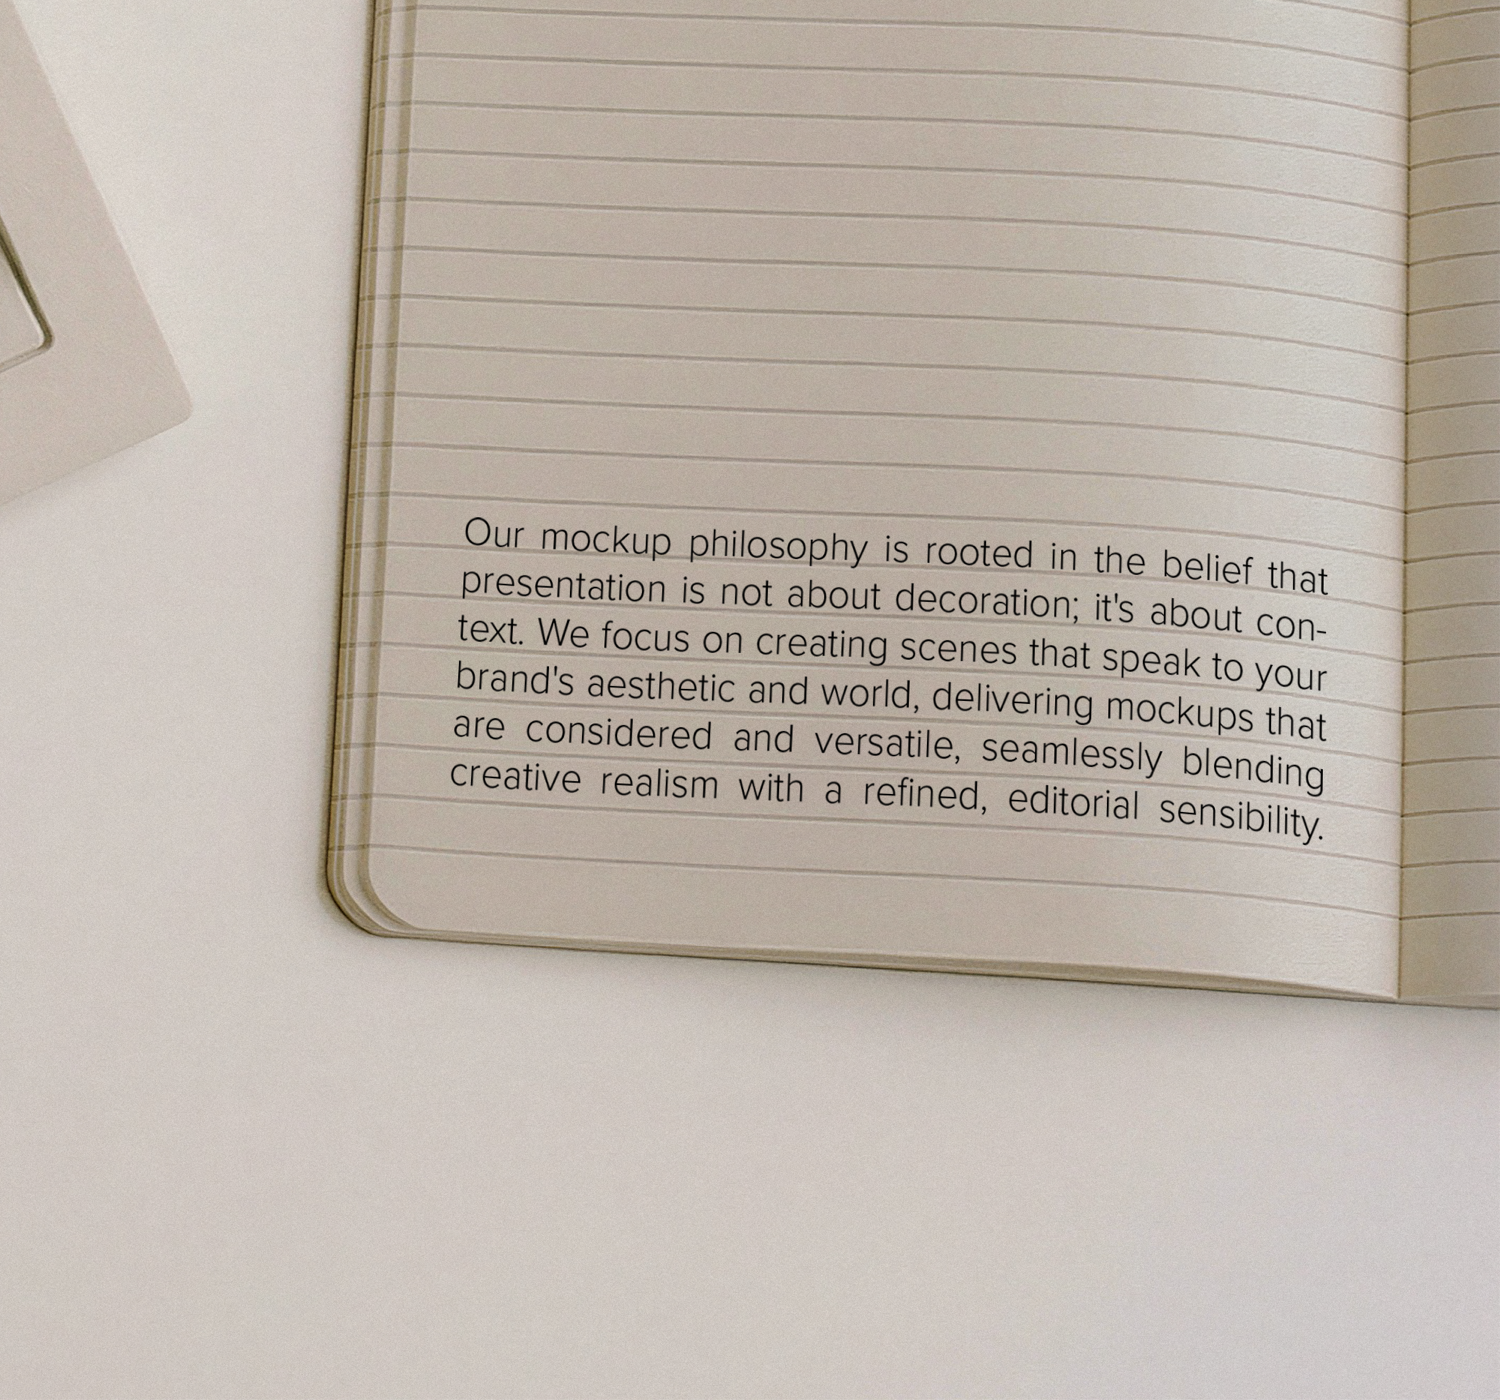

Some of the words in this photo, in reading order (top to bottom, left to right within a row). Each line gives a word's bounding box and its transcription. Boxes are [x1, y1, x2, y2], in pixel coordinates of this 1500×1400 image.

[465, 516, 525, 548] Our
[542, 525, 671, 562] mockup
[690, 528, 869, 569] philosophy
[886, 535, 909, 564] is
[926, 540, 1033, 568] rooted
[1051, 542, 1076, 571] in
[1094, 545, 1146, 576] the
[1164, 549, 1254, 585] belief
[1267, 561, 1329, 596] that
[462, 571, 665, 603] presentation
[682, 576, 705, 605] is
[721, 580, 773, 607] not
[787, 579, 881, 611] about
[895, 582, 1078, 625] decoration;
[1095, 592, 1134, 623] it's
[1150, 597, 1243, 633] about
[1256, 613, 1327, 642] con-
[457, 614, 524, 645] text.
[537, 617, 589, 648] We
[601, 620, 689, 653] focus
[702, 631, 742, 654] on
[756, 630, 887, 667] creating
[900, 637, 1017, 665] scenes
[1029, 637, 1091, 670] that
[1102, 647, 1201, 679] speak
[1211, 652, 1244, 682] to
[1254, 662, 1328, 692] your
[457, 660, 574, 696] brand's
[587, 671, 735, 703] aesthetic
[748, 676, 808, 705] and
[821, 678, 919, 714] world,
[932, 681, 1093, 726] delivering
[1107, 695, 1254, 736] mockups
[1265, 706, 1327, 742] that
[453, 715, 505, 741] are
[526, 718, 712, 750] considered
[734, 724, 794, 753] and
[814, 729, 960, 765] versatile,
[982, 737, 1163, 779] seamlessly
[1183, 745, 1324, 798] blending
[450, 762, 581, 794] creative
[602, 767, 718, 799] realism
[738, 772, 803, 803] with
[825, 781, 842, 805] a
[864, 776, 987, 815] refined,
[1008, 784, 1138, 820] editorial
[1160, 799, 1323, 846] sensibility.
